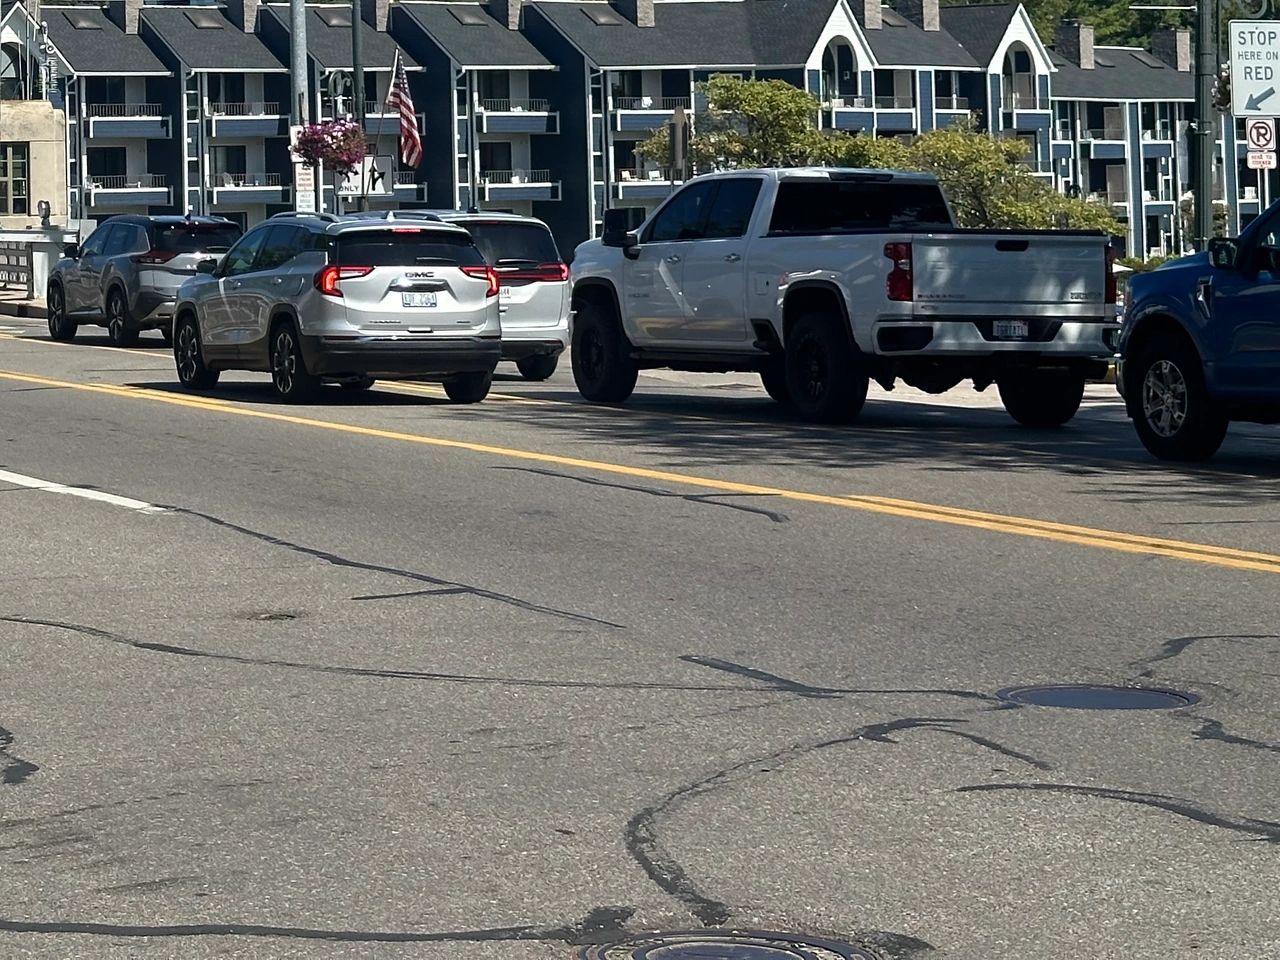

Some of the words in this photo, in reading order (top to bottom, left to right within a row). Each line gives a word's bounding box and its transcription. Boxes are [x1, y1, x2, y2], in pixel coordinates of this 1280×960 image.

[1238, 31, 1277, 45] STOP
[1237, 51, 1262, 60] HERE
[1266, 51, 1279, 60] ON
[1244, 66, 1273, 80] RED
